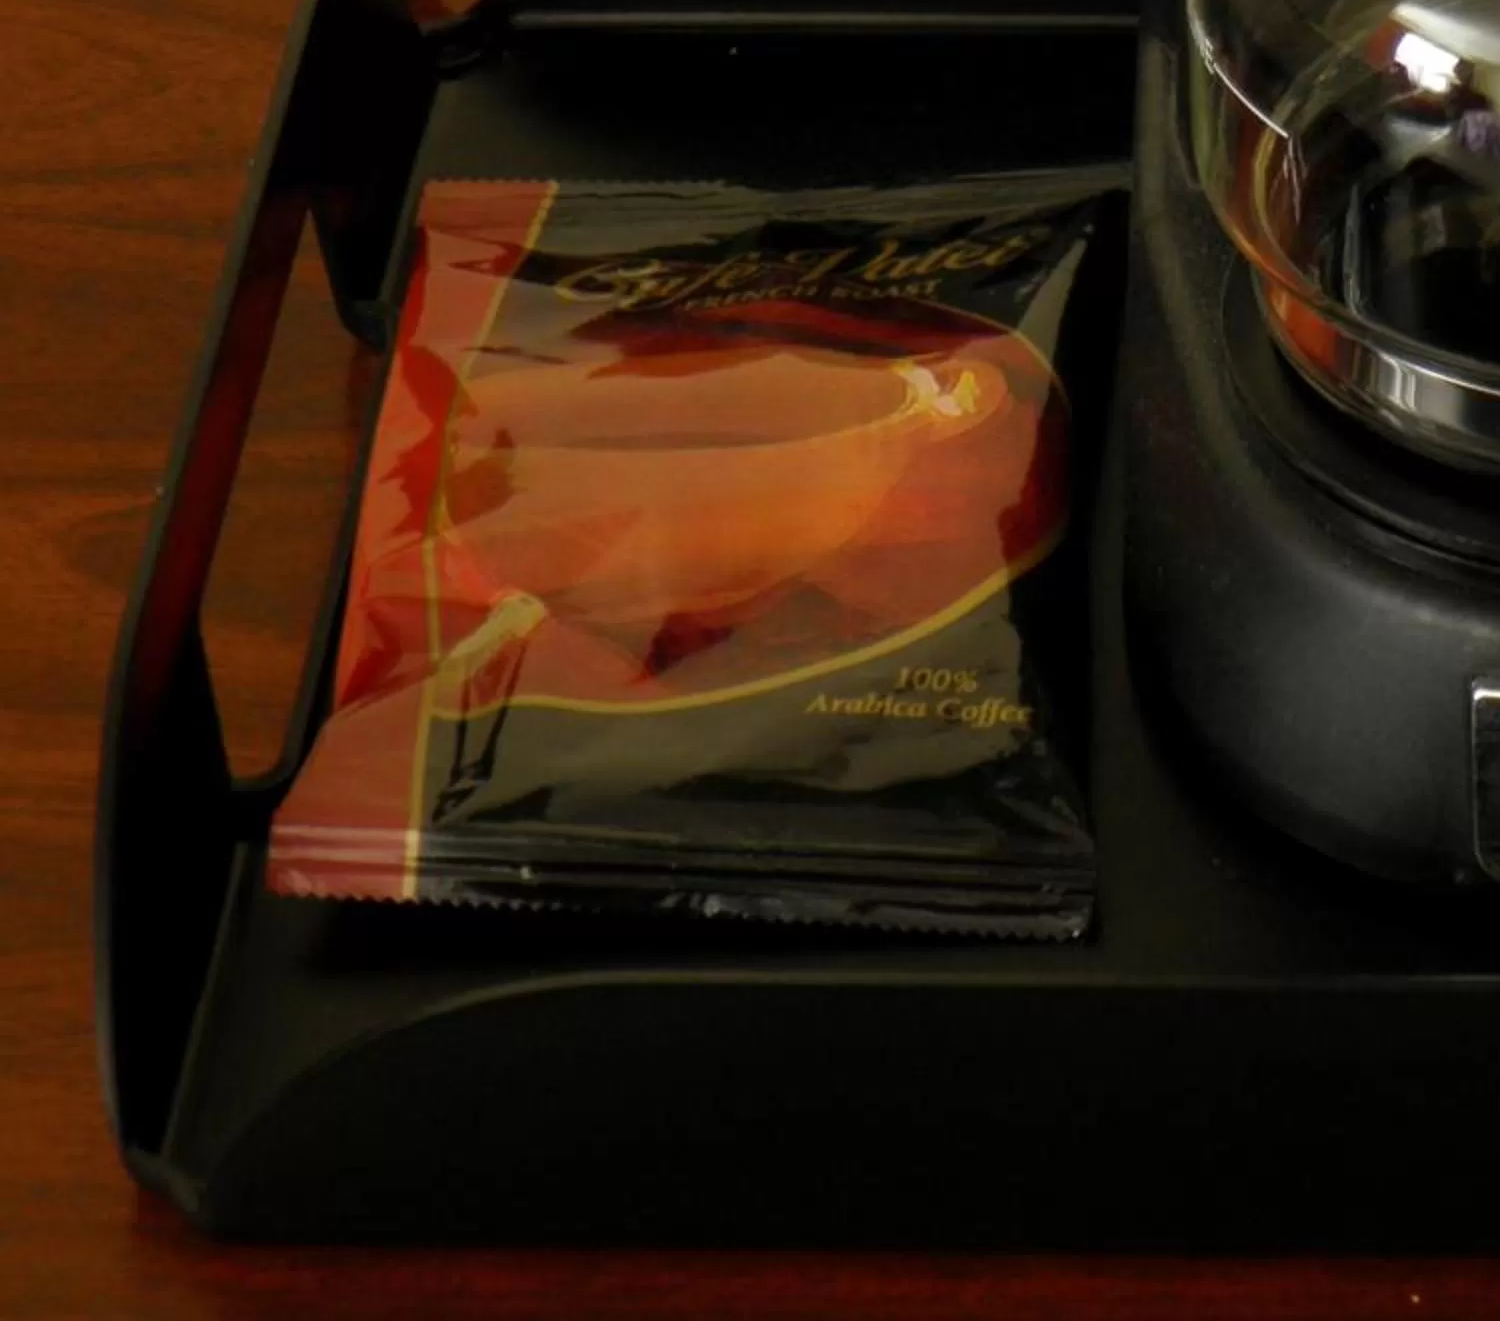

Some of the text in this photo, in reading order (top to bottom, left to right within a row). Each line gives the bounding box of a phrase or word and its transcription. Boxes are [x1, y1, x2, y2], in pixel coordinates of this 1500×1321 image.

[893, 666, 981, 693] 100%
[804, 691, 1034, 727] Arabica Coffee
